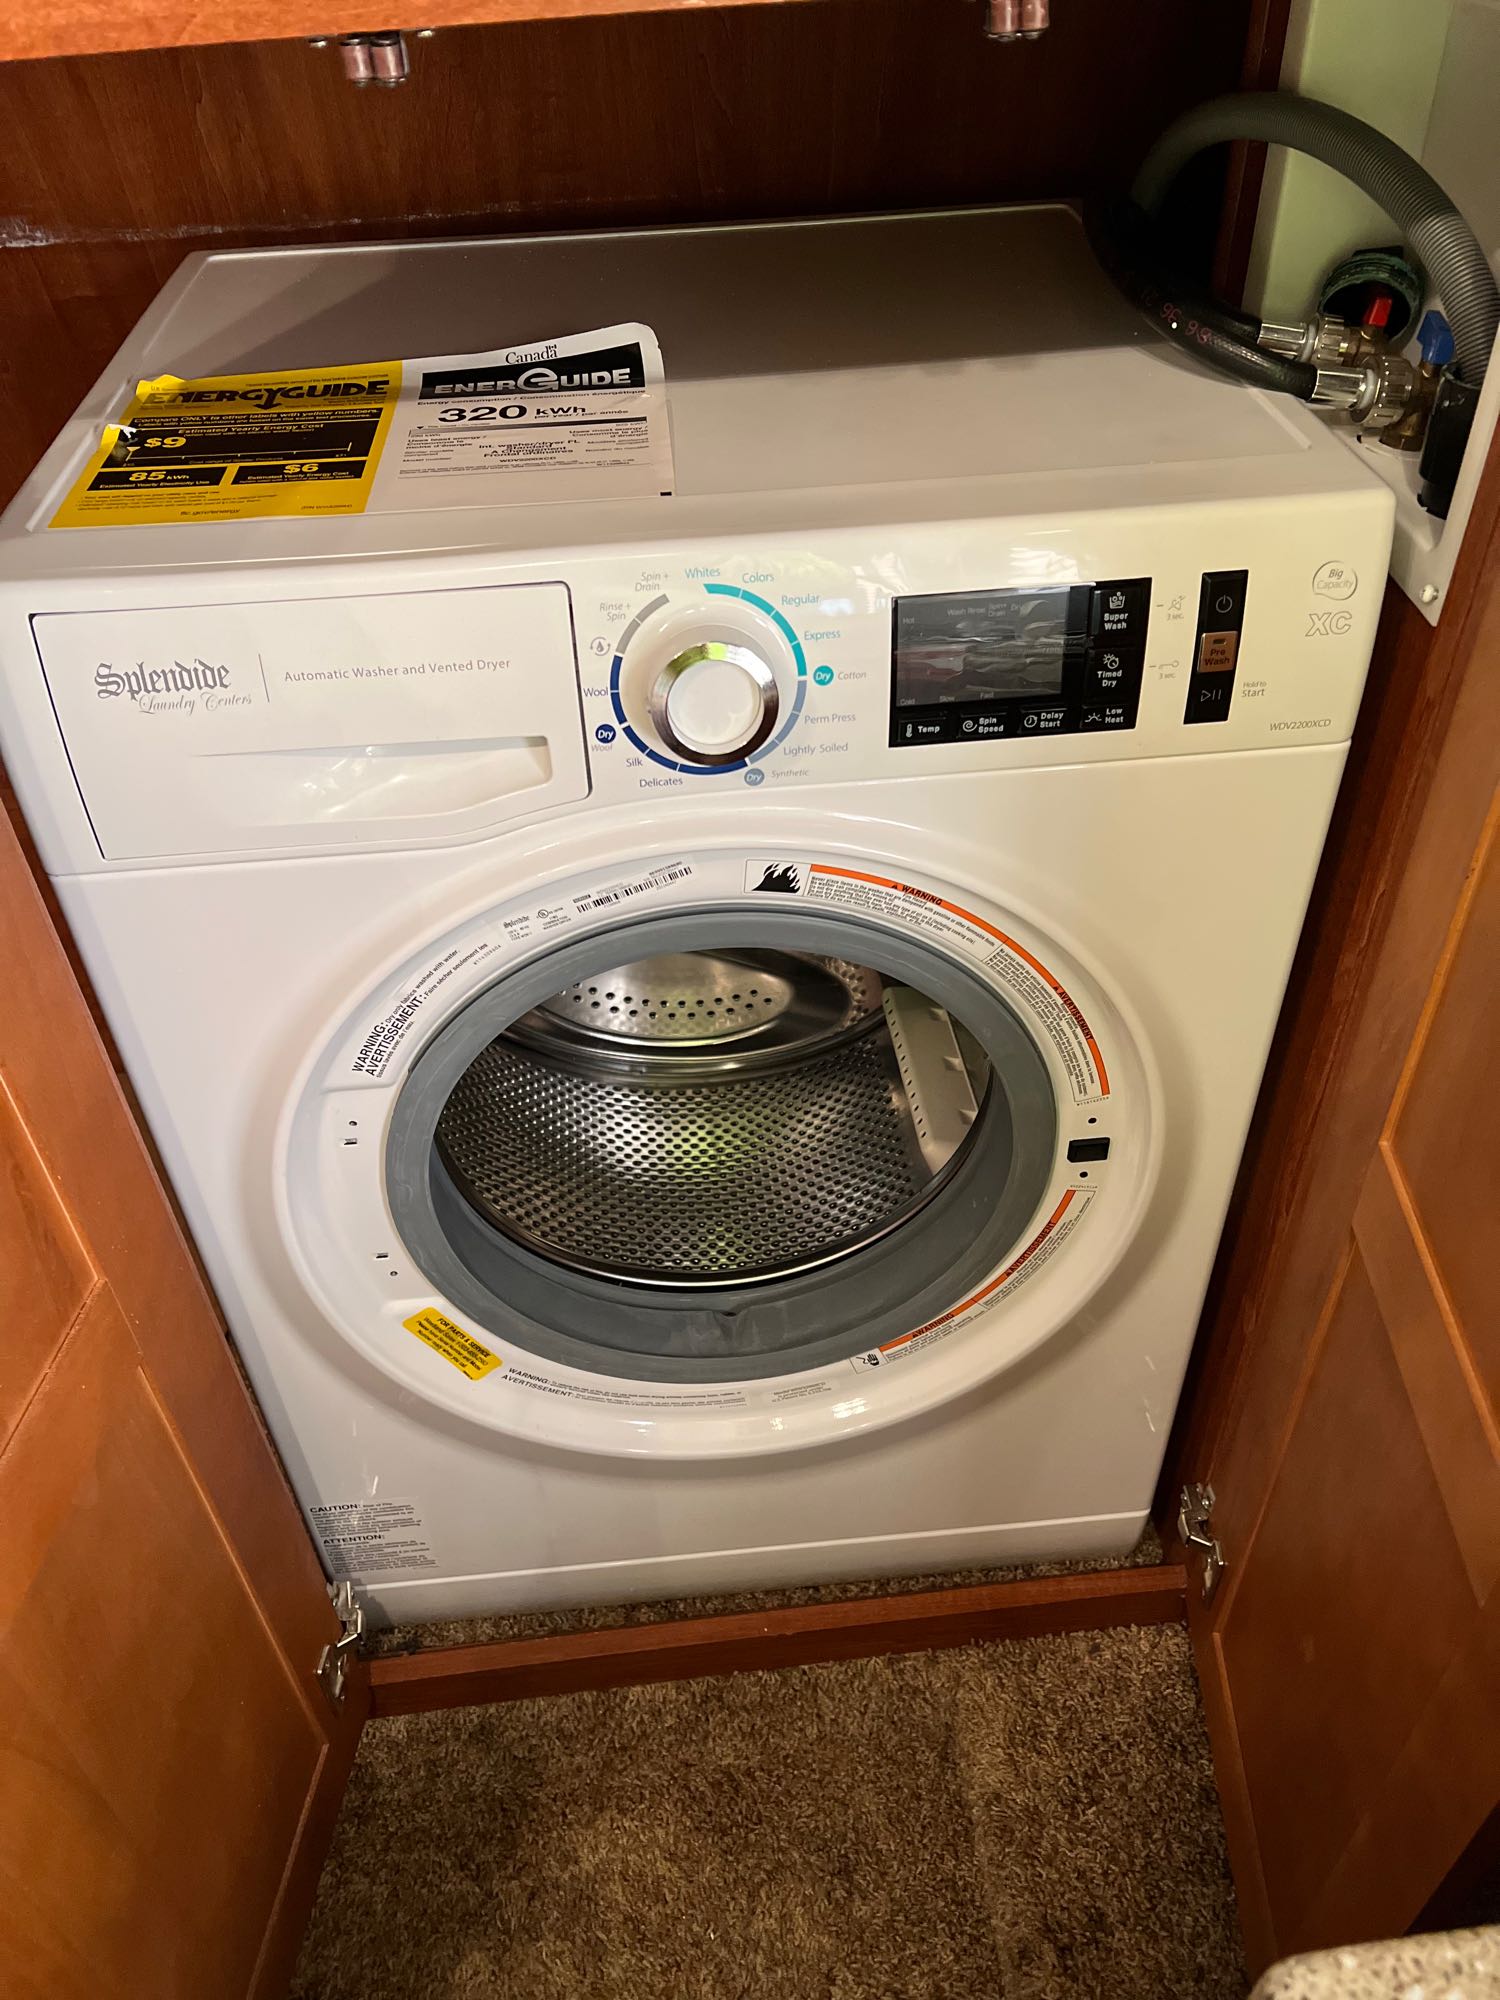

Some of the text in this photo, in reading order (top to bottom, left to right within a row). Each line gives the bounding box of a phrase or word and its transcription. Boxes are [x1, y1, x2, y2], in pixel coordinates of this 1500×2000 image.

[505, 345, 558, 365] Canada
[434, 367, 631, 394] ENERGUIDE
[438, 404, 586, 422] 320 kWh
[144, 436, 187, 448] $9
[283, 463, 319, 474] $6
[129, 471, 167, 481] 85
[641, 572, 662, 582] Spin
[685, 568, 720, 579] Whites
[742, 573, 774, 584] Colors
[1328, 569, 1343, 580] Big
[635, 582, 660, 591] Drain
[1316, 580, 1354, 590] Capacity
[781, 594, 820, 606] Regular
[600, 602, 623, 611] Rinse
[607, 612, 626, 622] Spin
[1104, 613, 1128, 621] Super
[1104, 622, 1126, 630] Wash
[1305, 611, 1352, 636] XC
[804, 630, 840, 642] Express
[1205, 658, 1230, 666] Wash
[285, 659, 511, 682] Automatic Washer and Vented Dryer
[1097, 670, 1122, 678] Timed
[94, 658, 231, 702] Splendide
[815, 670, 866, 683] Dry Cotton
[583, 687, 608, 697] Wool
[1242, 688, 1265, 697] Start
[138, 691, 252, 717] Laundry Centers
[804, 713, 856, 724] Perm Press
[979, 717, 997, 725] Spin
[1041, 712, 1063, 720] Delay
[918, 725, 940, 733] Temp
[978, 725, 1003, 734] Speed
[1040, 720, 1060, 728] Start
[1269, 719, 1331, 731] WDV2200XCD
[598, 729, 614, 741] Dry
[784, 743, 848, 757] Lightly Soiled
[626, 758, 643, 767] Silk
[747, 769, 809, 783] Dry Synthetic
[639, 778, 683, 788] Delicates
[901, 885, 943, 906] WARNING
[363, 993, 427, 1075] AVERTISSEMENT:
[423, 983, 438, 996] Faire
[434, 969, 454, 985] sécher
[450, 948, 480, 970] seulement
[477, 942, 488, 951] les
[351, 1020, 389, 1072] WARNING:
[391, 1003, 404, 1015] only
[399, 988, 417, 1004] fabrics
[413, 970, 435, 989] washed
[431, 961, 445, 972] with
[447, 1325, 466, 1339] PARTS
[467, 1341, 490, 1358] SERVICE
[509, 1367, 551, 1385] WARNING:
[501, 1374, 575, 1398] AVERTISSEMENT:
[310, 1503, 361, 1513] CAUTION:
[323, 1534, 385, 1545] ATTENTION:
